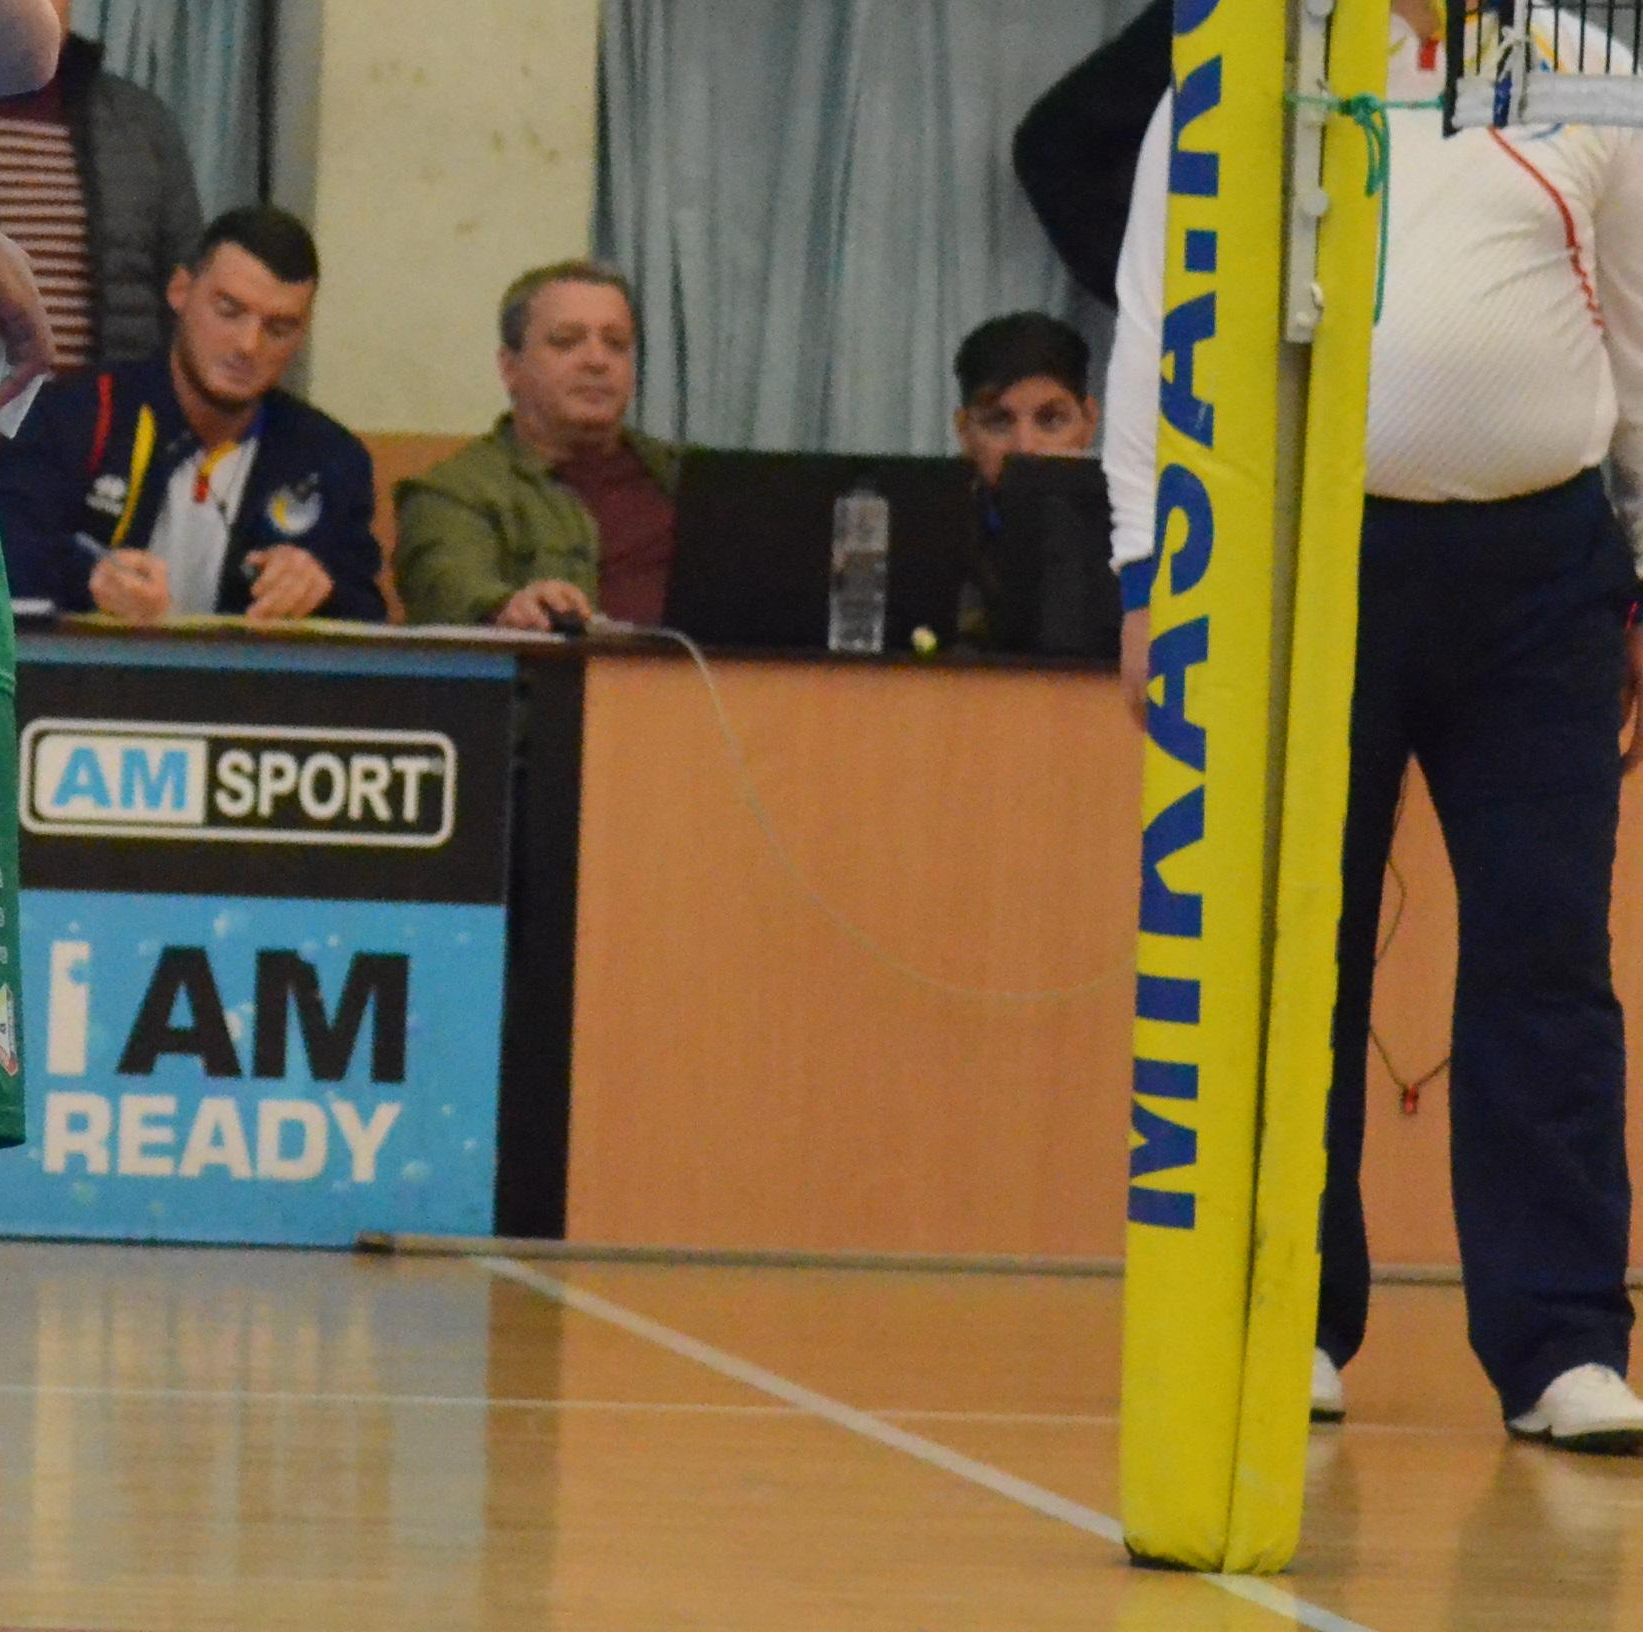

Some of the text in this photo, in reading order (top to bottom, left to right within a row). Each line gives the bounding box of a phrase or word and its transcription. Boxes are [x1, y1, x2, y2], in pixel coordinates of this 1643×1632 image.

[52, 747, 432, 824] AM SPORT
[116, 945, 410, 1083] AM
[42, 1092, 402, 1183] READY
